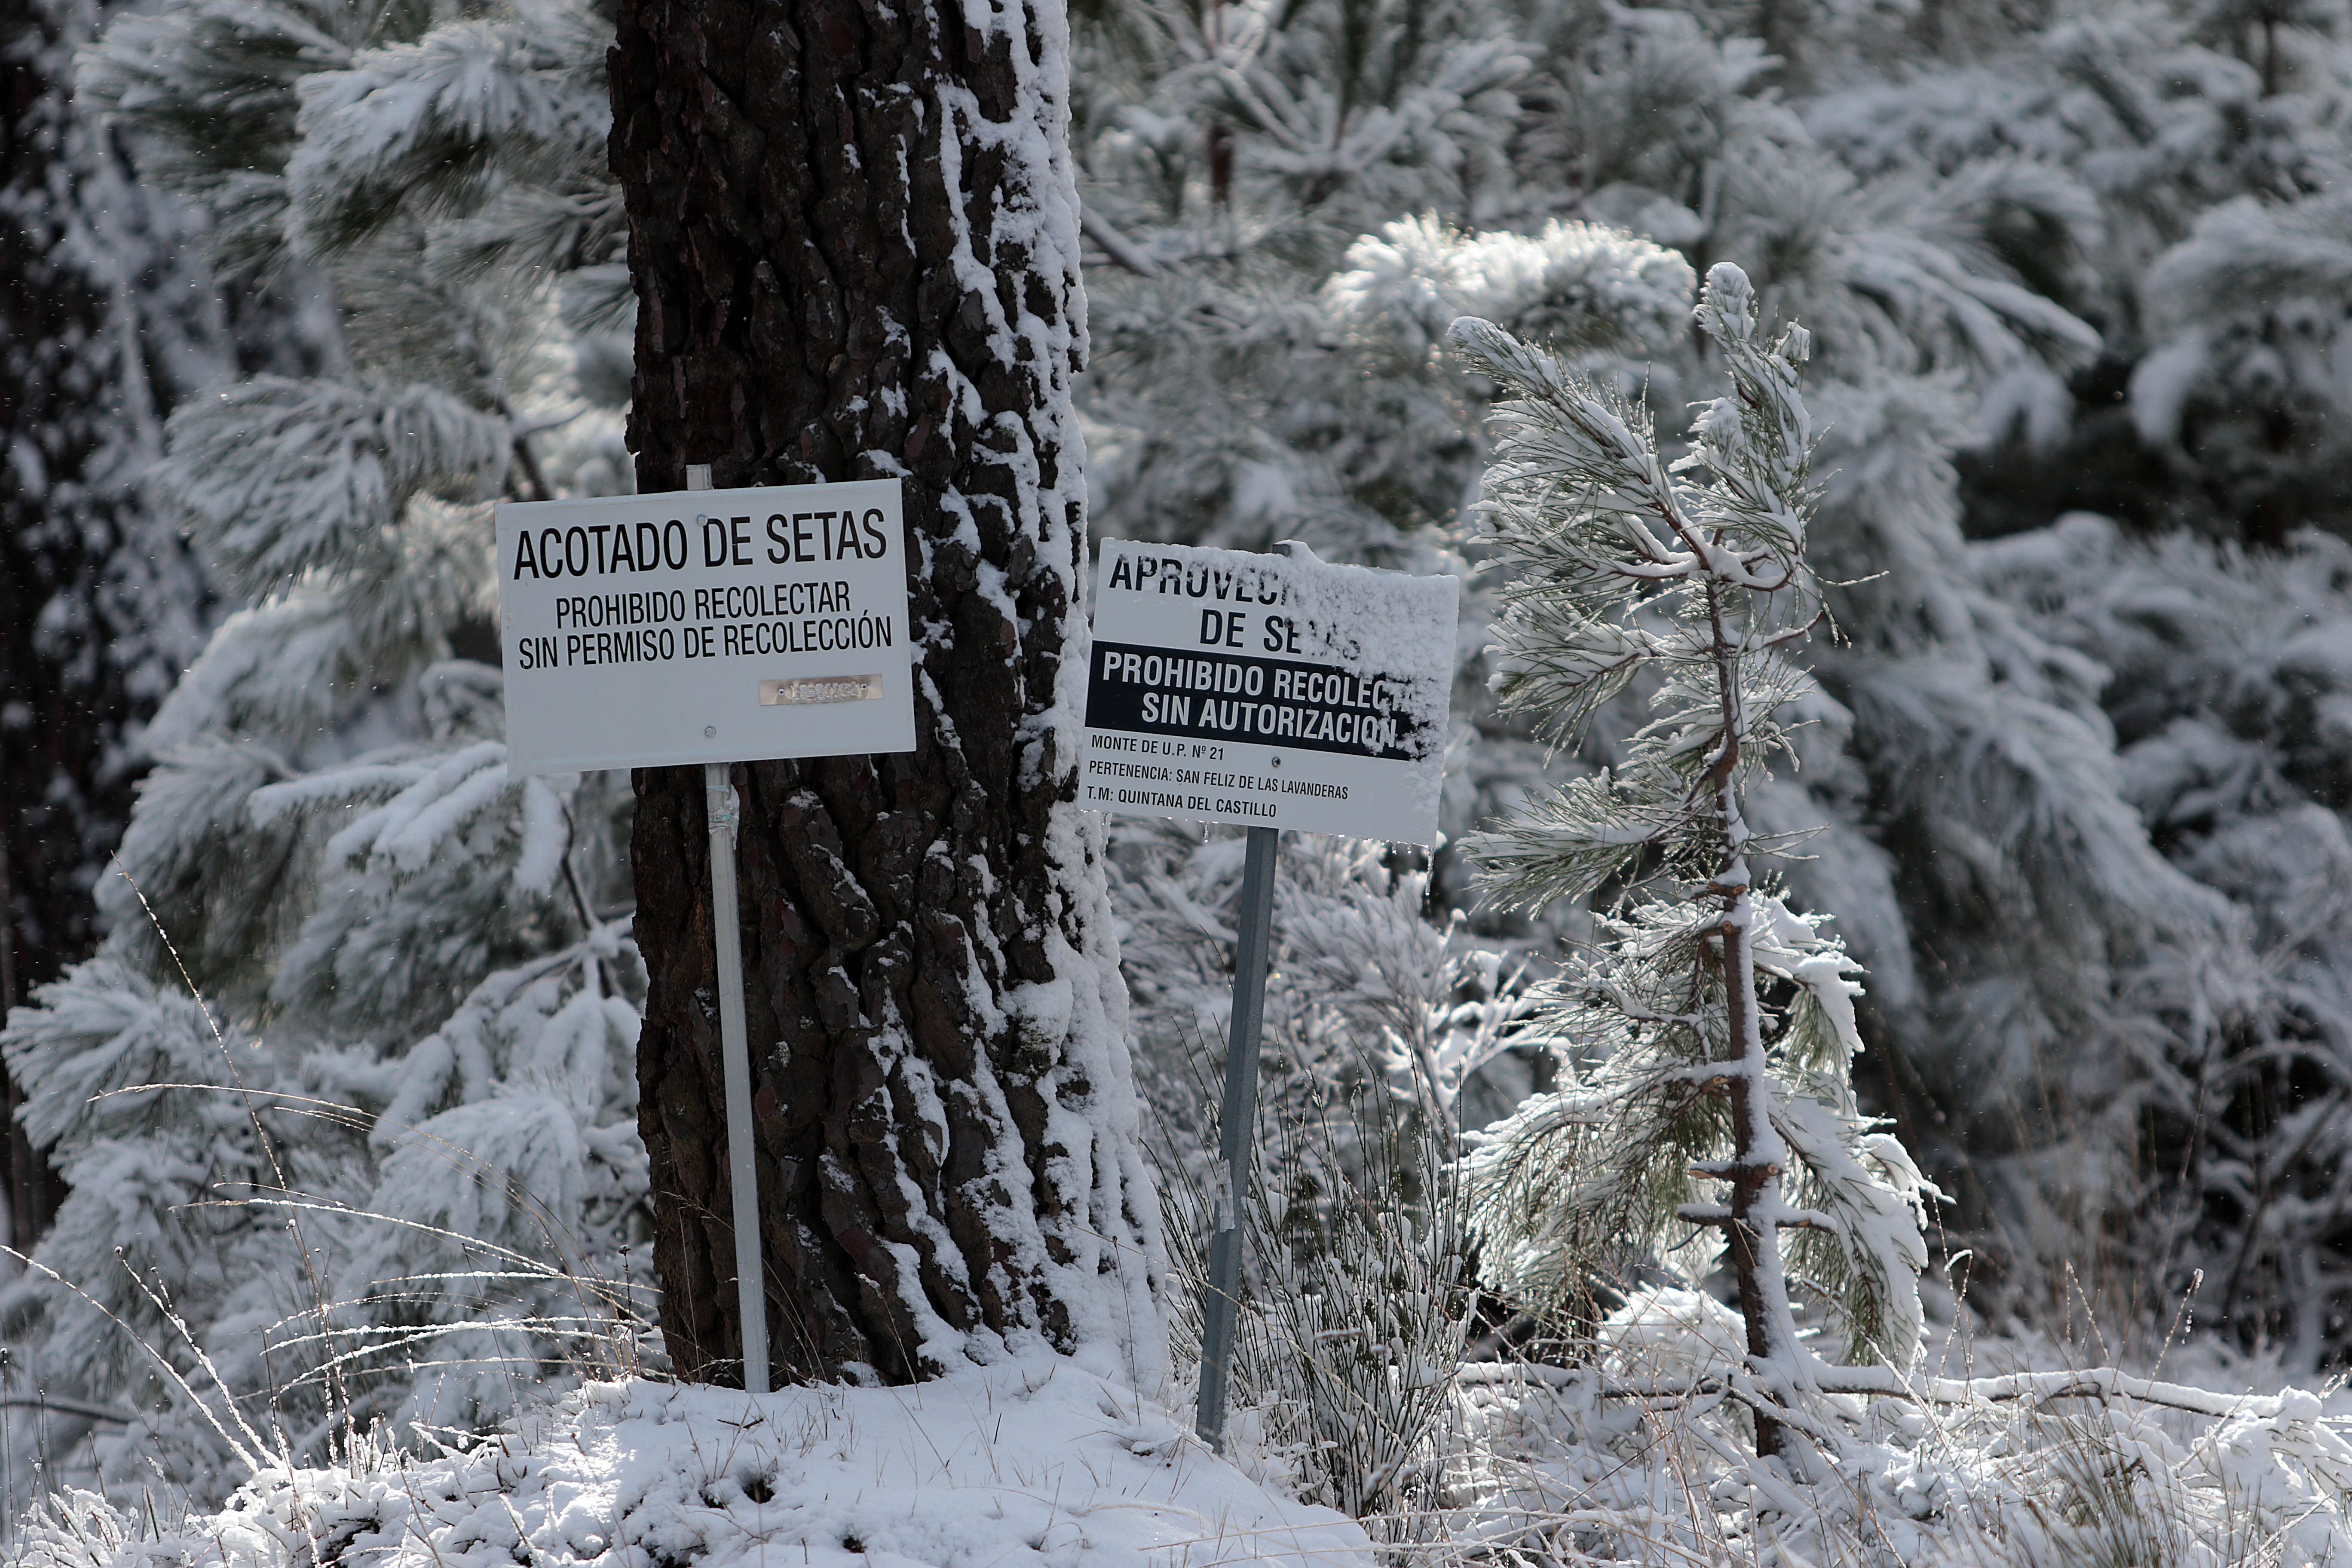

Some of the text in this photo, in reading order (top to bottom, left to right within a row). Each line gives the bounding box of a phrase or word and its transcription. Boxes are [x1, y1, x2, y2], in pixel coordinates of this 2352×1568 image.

[514, 508, 886, 580] ACOTADO DE SETAS
[556, 581, 851, 629] PROHIBIDO RECOLECTAR
[519, 609, 891, 670] SIN PERMISO DE RECOLECCIÓN
[1200, 609, 1246, 648] DE
[1103, 651, 1264, 696] PROHIBIDO
[1142, 692, 1190, 726] SIN
[1091, 735, 1224, 760] MONTE DE U.P. Nº 21
[1089, 760, 1348, 799] PERTENENCIA: SAN FELIZ DE LAS LAVANDERAS
[1087, 786, 1276, 818] T.M: QUINTANA DEL CASTILLO
